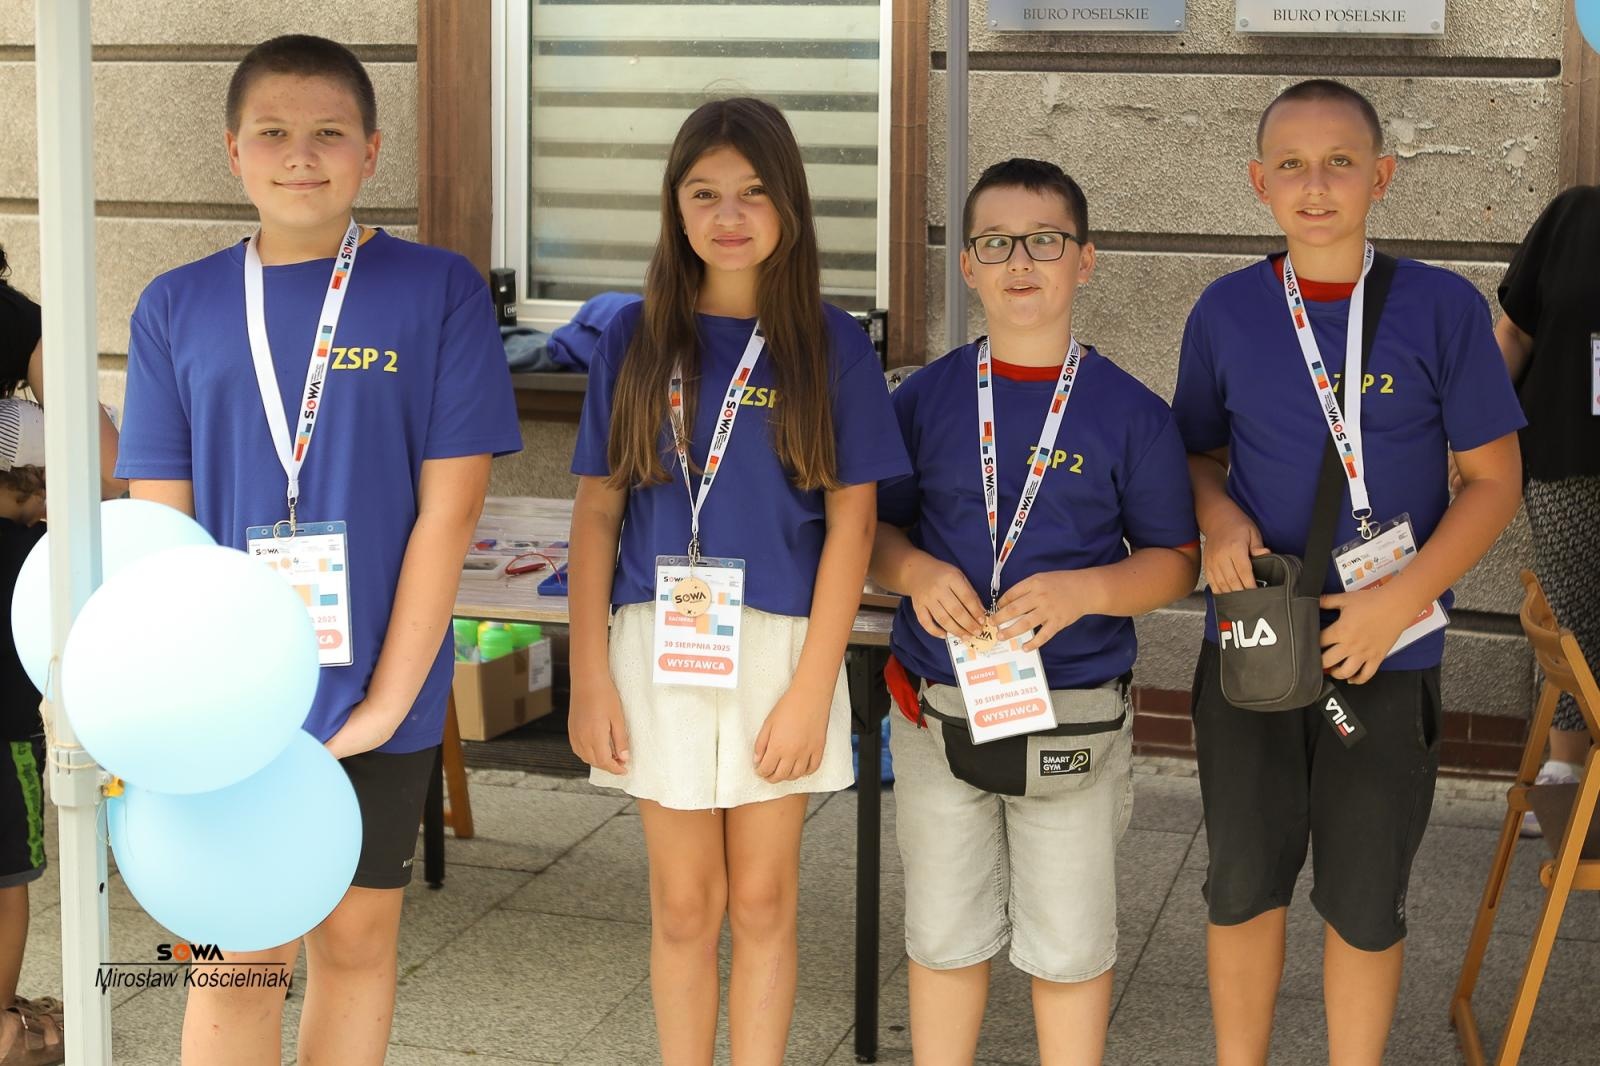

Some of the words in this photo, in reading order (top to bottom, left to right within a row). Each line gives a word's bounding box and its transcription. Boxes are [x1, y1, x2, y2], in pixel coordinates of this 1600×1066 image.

[1023, 8, 1068, 20] BIURO
[1072, 8, 1149, 20] POSELSKIE
[1273, 9, 1320, 22] BIURO
[1325, 9, 1406, 23] POSELSKIE
[331, 347, 379, 370] ZSP
[383, 350, 398, 373] 2
[1063, 354, 1078, 382] SOWA
[1380, 373, 1394, 394] 2
[304, 380, 321, 419] SOWA
[718, 401, 736, 435] SOWA
[1328, 406, 1346, 441] SOWA
[1069, 453, 1084, 474] 2
[984, 457, 995, 494] SOWA
[1015, 496, 1033, 529] SOWA
[674, 591, 706, 604] SOWA
[1219, 617, 1278, 650] FILA
[666, 658, 726, 671] WYSTAWCA
[982, 703, 1040, 723] WYSTAWCA
[1325, 697, 1355, 737] FILA
[1042, 756, 1070, 764] SMART
[1042, 763, 1061, 771] GYM
